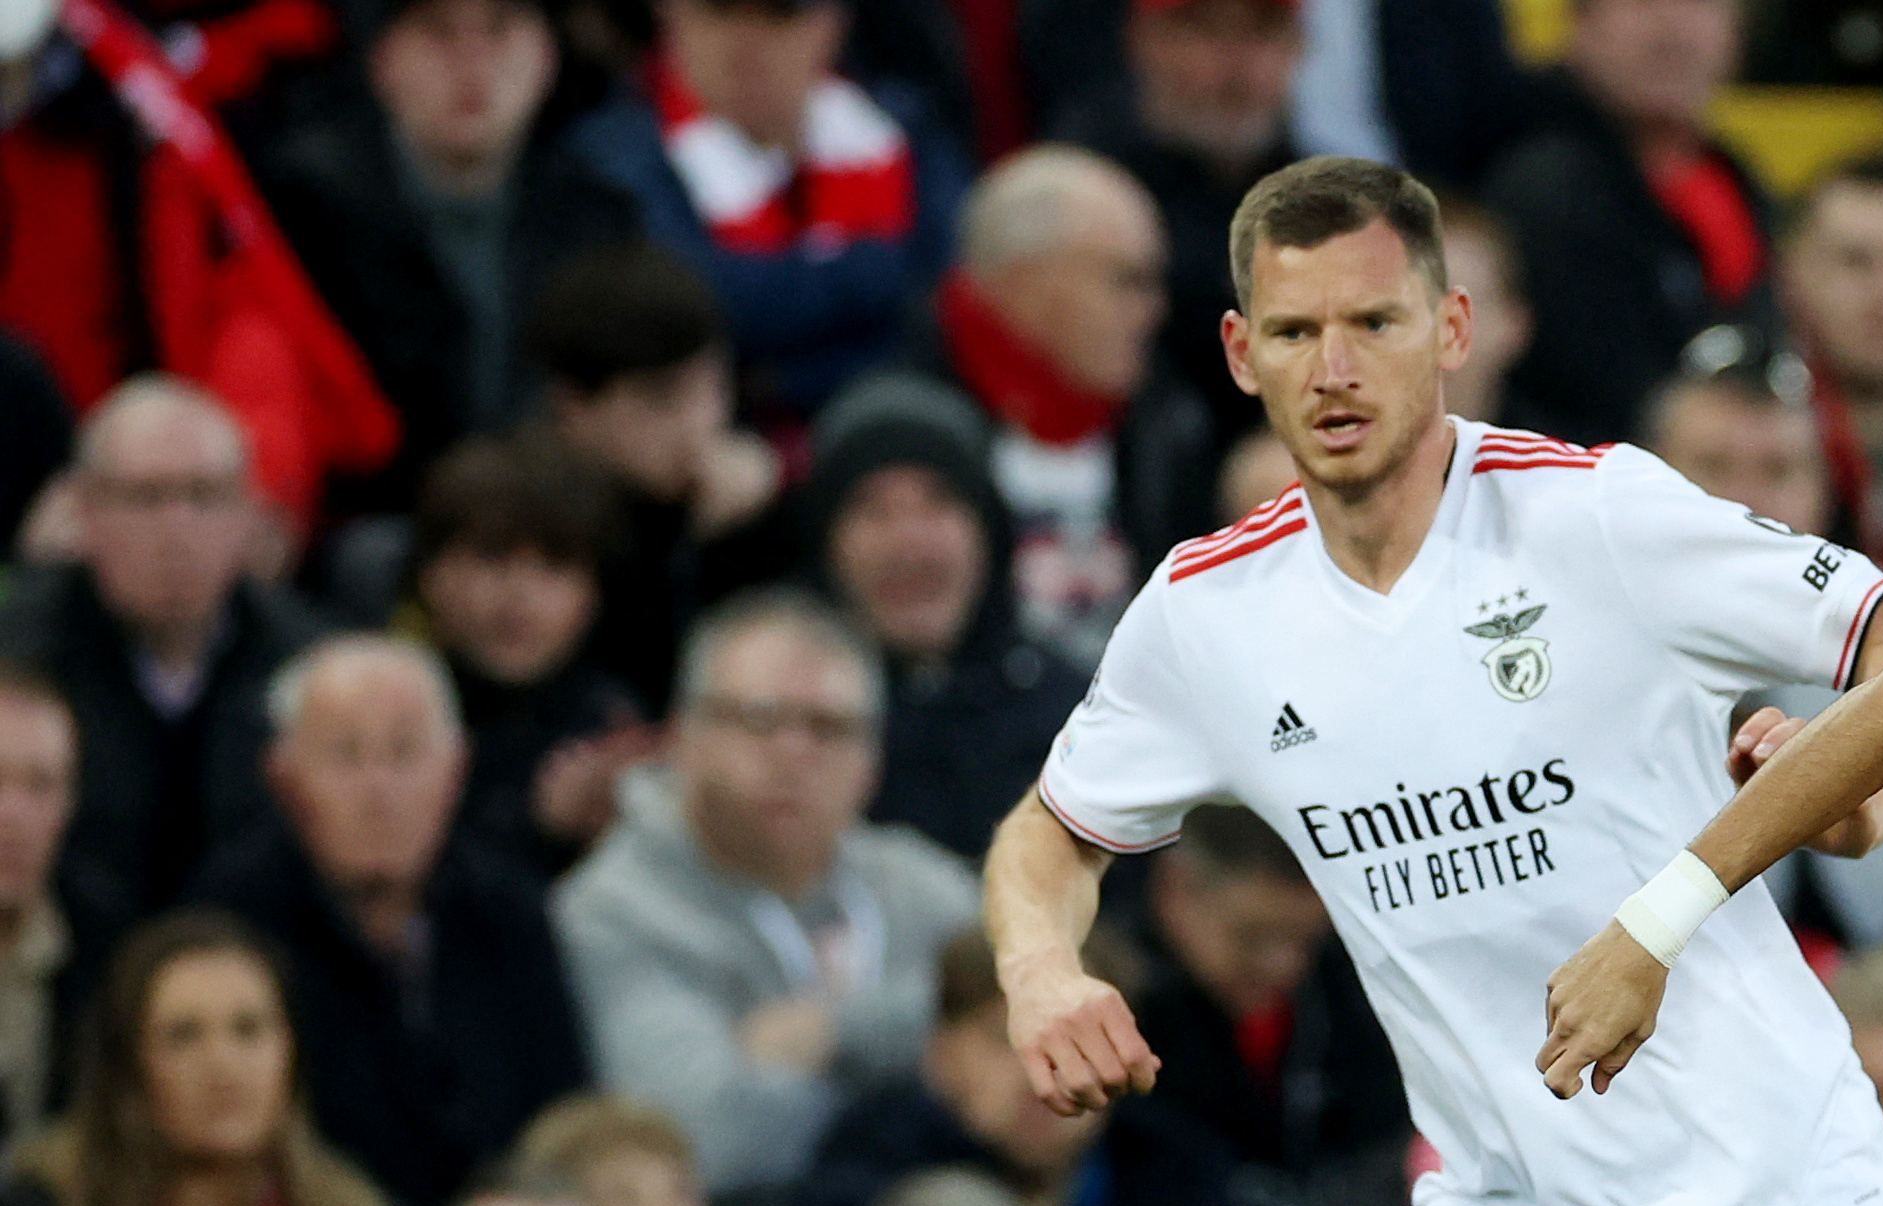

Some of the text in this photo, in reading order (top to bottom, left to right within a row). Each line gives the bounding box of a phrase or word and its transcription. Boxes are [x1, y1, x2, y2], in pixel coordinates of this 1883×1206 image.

[1270, 727, 1318, 753] adidas
[1297, 758, 1576, 860] Emirates
[1364, 828, 1556, 913] FLY BETTER
